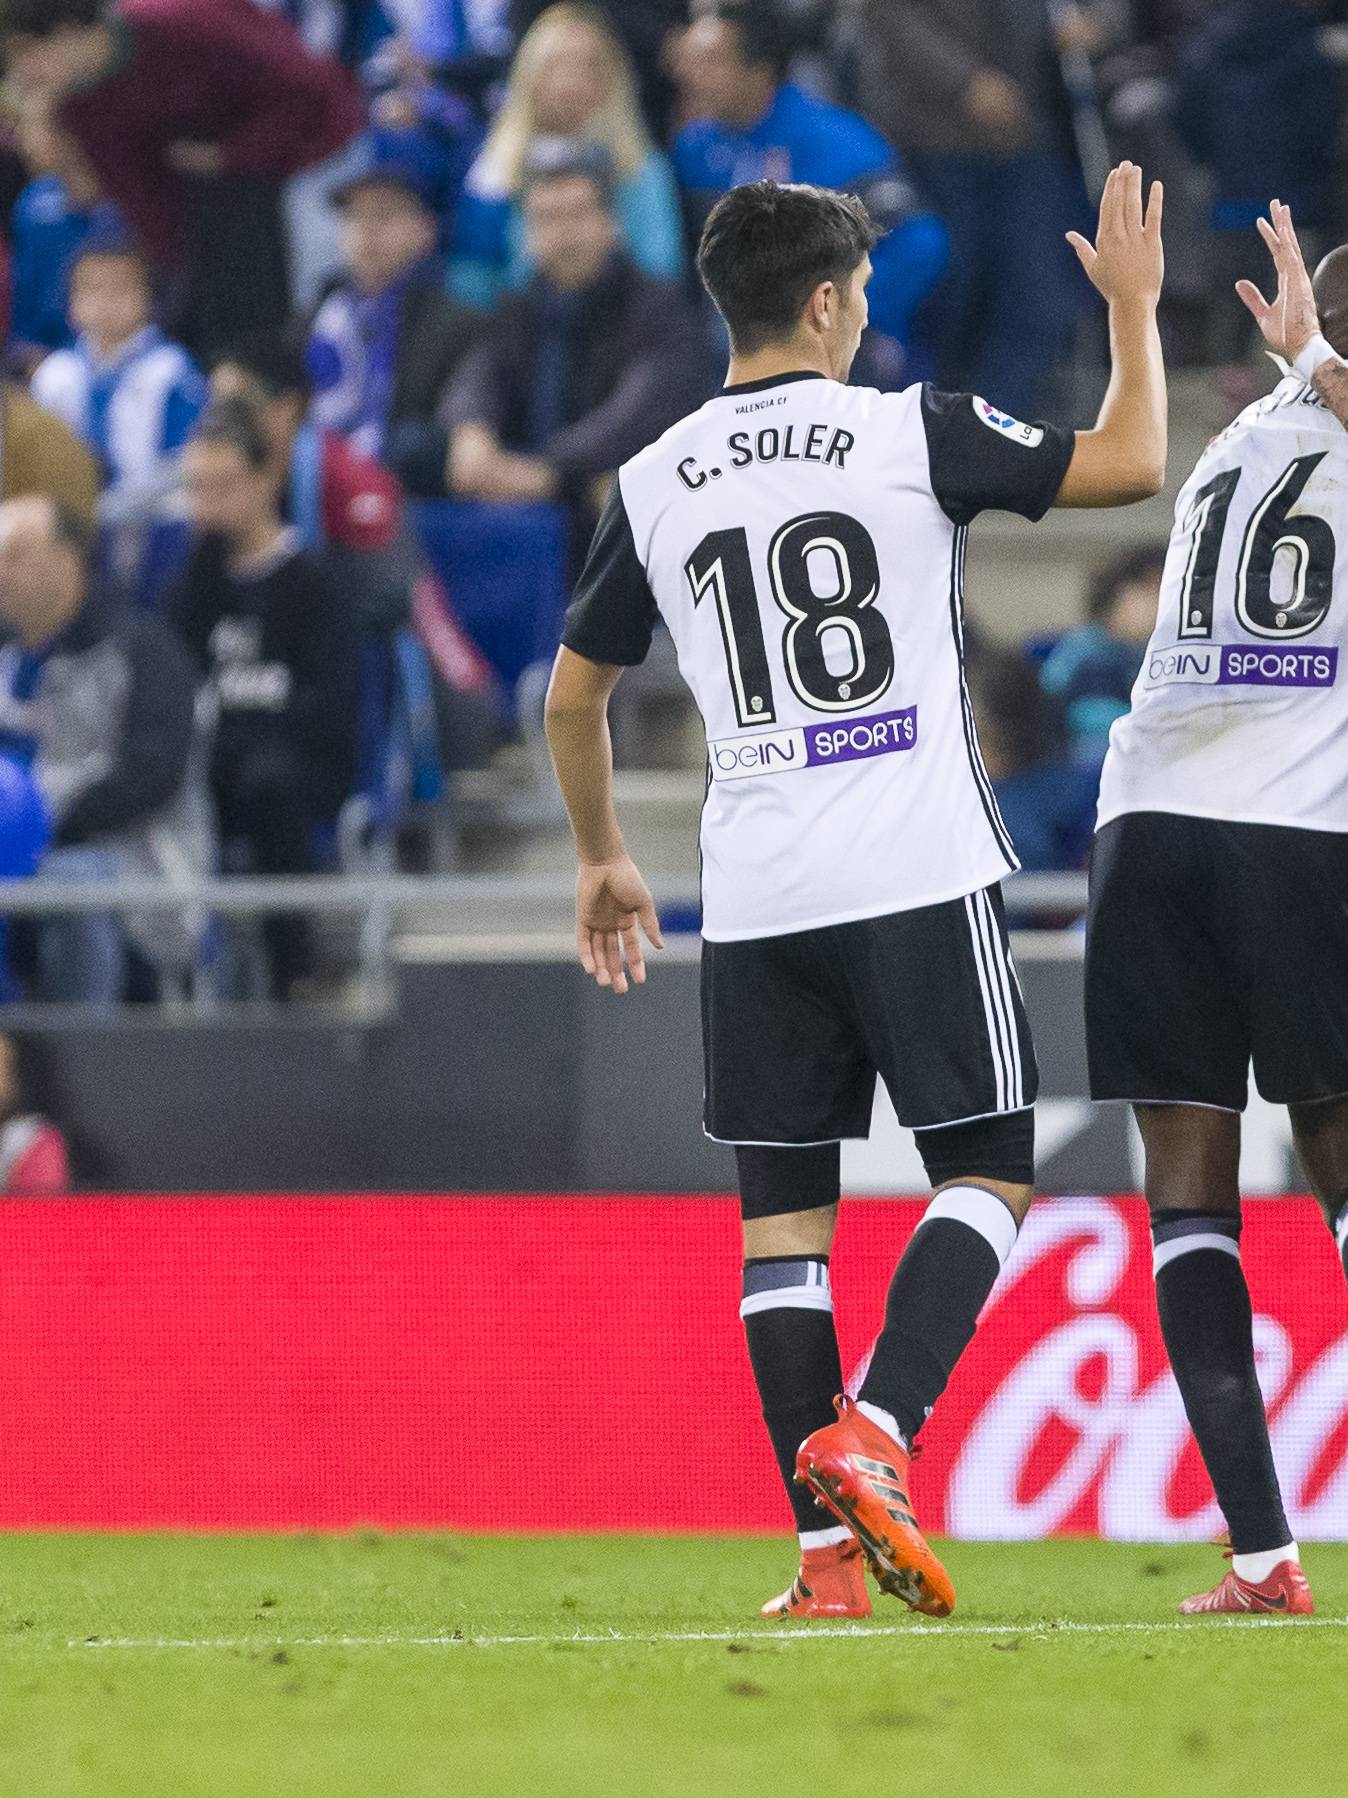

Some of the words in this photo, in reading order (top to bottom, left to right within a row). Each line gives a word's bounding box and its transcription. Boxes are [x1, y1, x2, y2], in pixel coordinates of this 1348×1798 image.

[735, 399, 775, 414] VALENCIA
[676, 456, 723, 492] C.
[727, 424, 855, 470] SOLER
[1177, 451, 1336, 640] 16
[683, 511, 895, 729] 18
[1227, 652, 1330, 679] SPORTS
[814, 715, 914, 757] SPORTS
